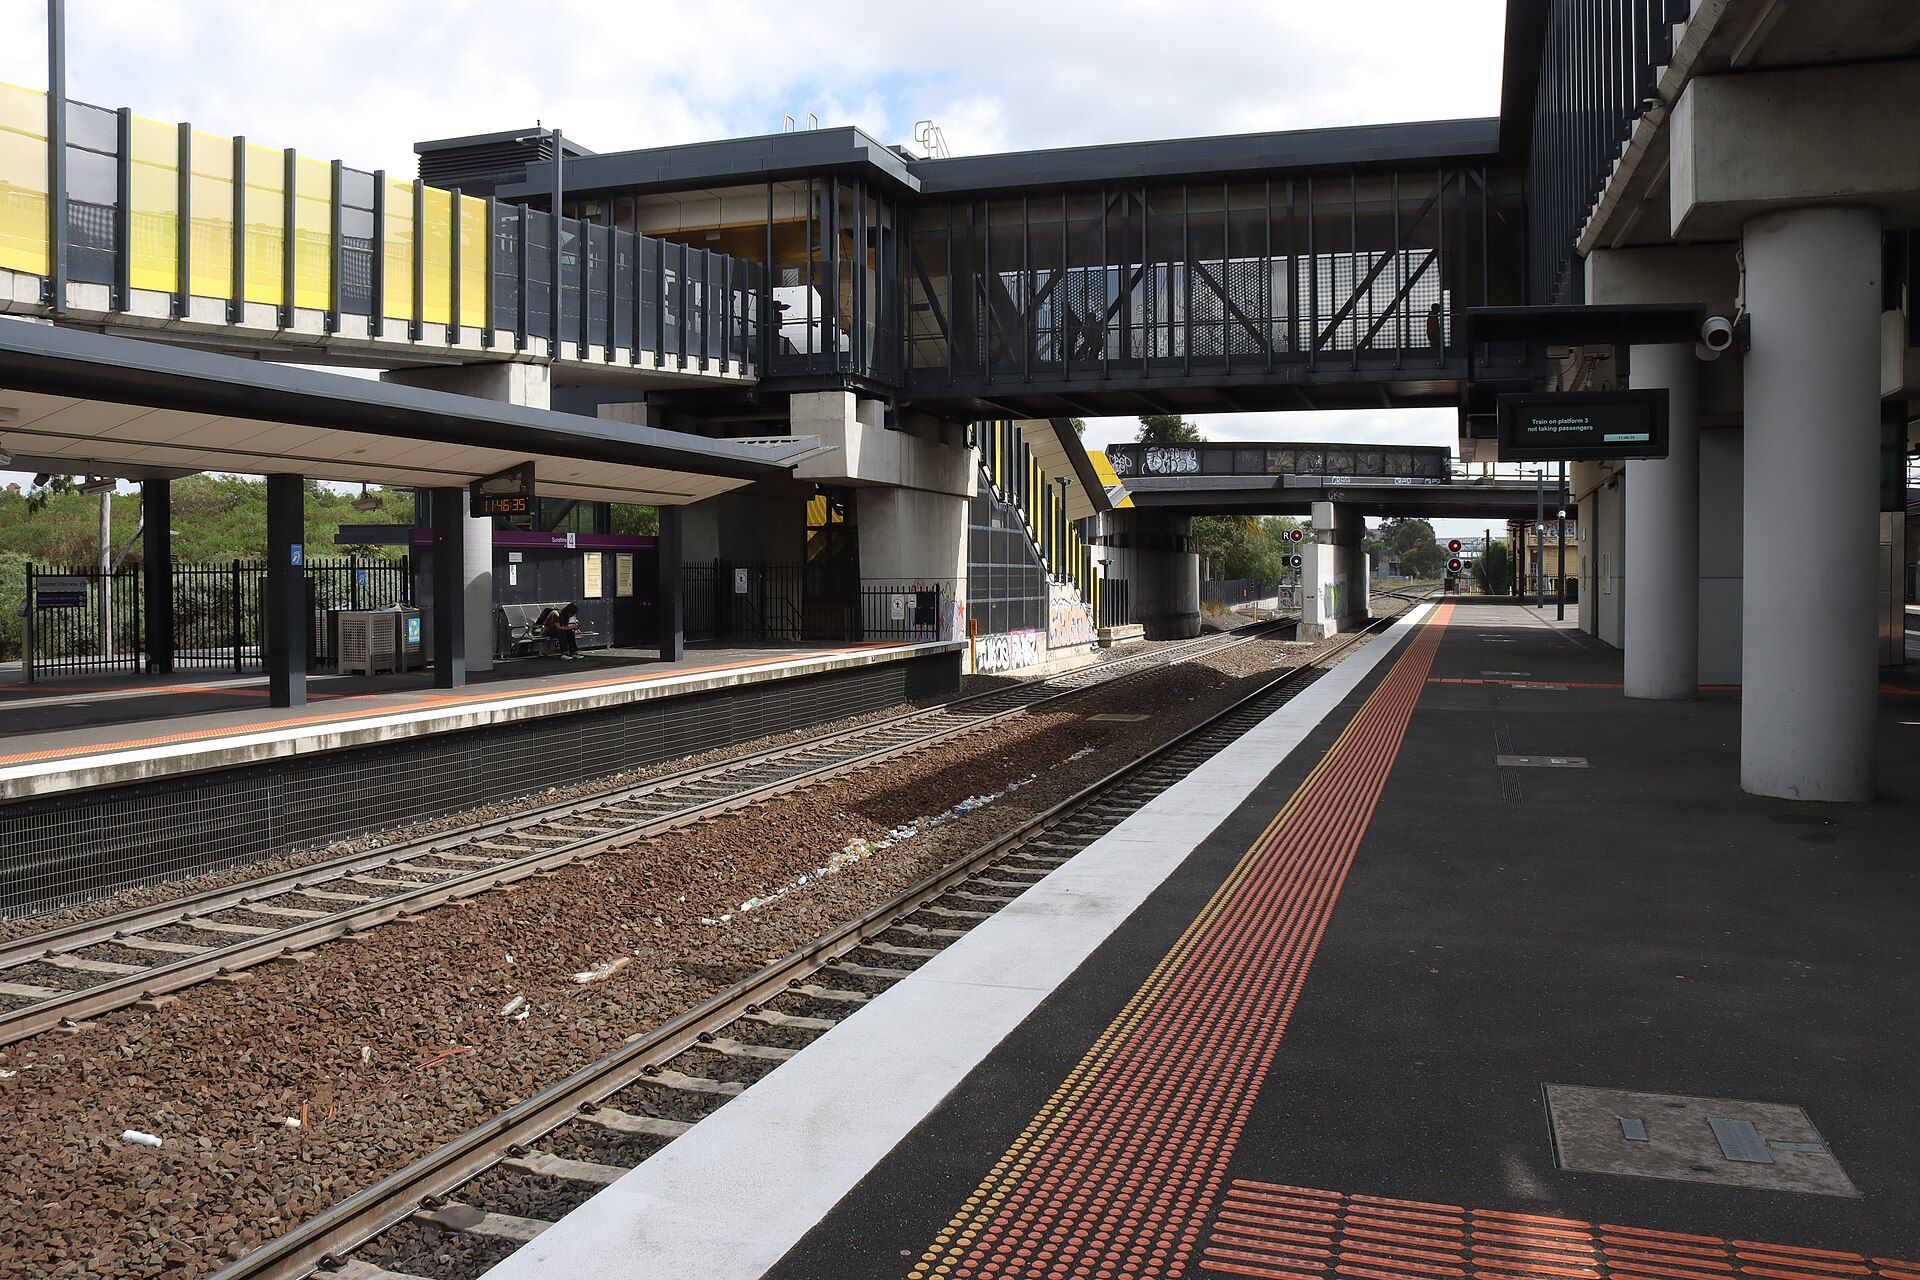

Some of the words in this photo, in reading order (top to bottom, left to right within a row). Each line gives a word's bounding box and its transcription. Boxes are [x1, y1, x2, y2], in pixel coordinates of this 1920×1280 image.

[1558, 417, 1584, 425] platform
[1558, 424, 1594, 432] passengers
[569, 534, 575, 545] 4
[1283, 532, 1289, 540] R
